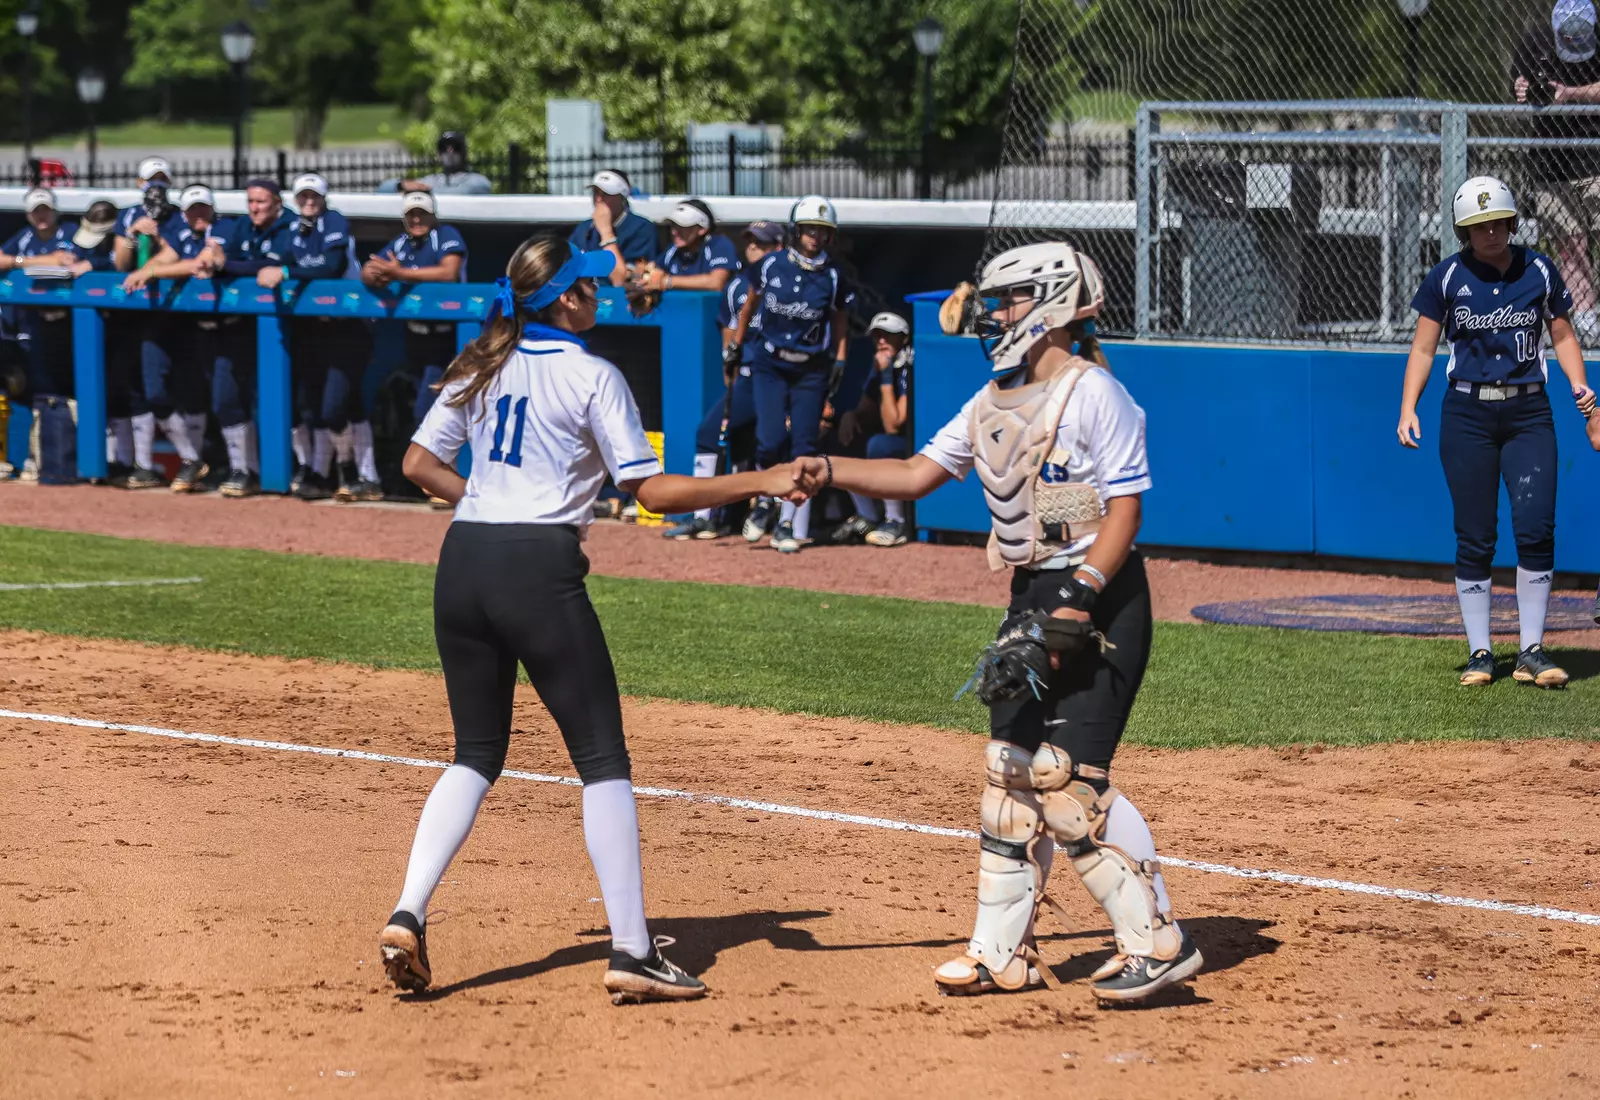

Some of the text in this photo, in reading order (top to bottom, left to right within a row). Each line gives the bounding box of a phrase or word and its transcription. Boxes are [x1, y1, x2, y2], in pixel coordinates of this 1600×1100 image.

[1455, 305, 1537, 329] Panthers
[1515, 330, 1536, 362] 10
[489, 394, 528, 468] 11
